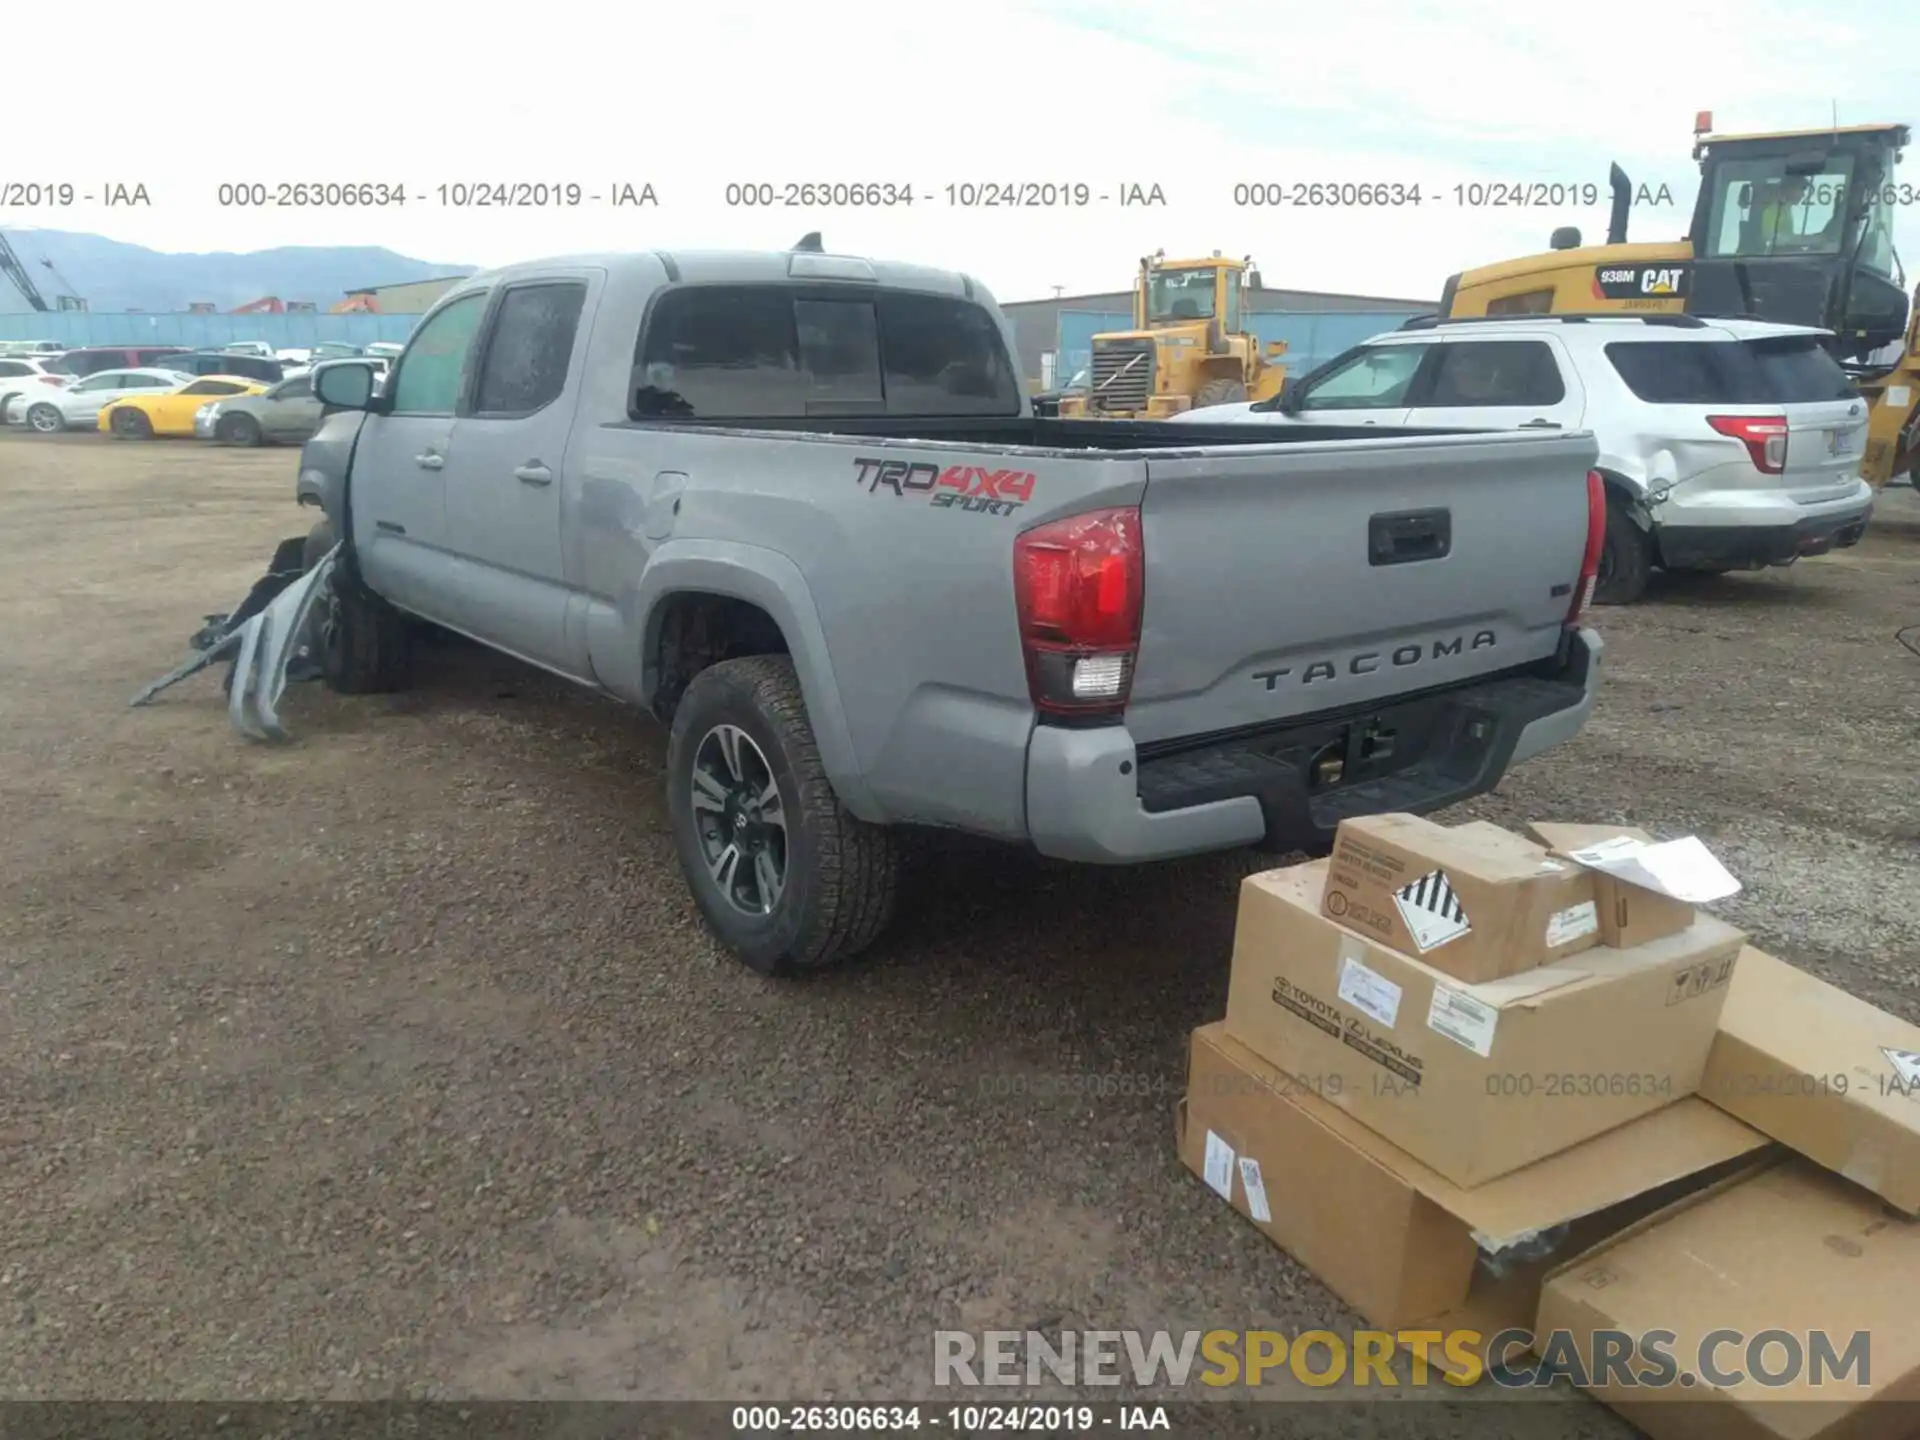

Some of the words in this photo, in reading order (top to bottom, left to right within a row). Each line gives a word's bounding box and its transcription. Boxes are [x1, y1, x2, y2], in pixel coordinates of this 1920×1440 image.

[1600, 270, 1635, 283] 938M
[1640, 269, 1684, 294] CAT
[853, 457, 939, 496] TRD
[930, 493, 1025, 517] SPORT
[1251, 629, 1497, 692] TACOMA
[1291, 985, 1343, 1025] TOYOTA
[1366, 1028, 1425, 1071] LEXUS
